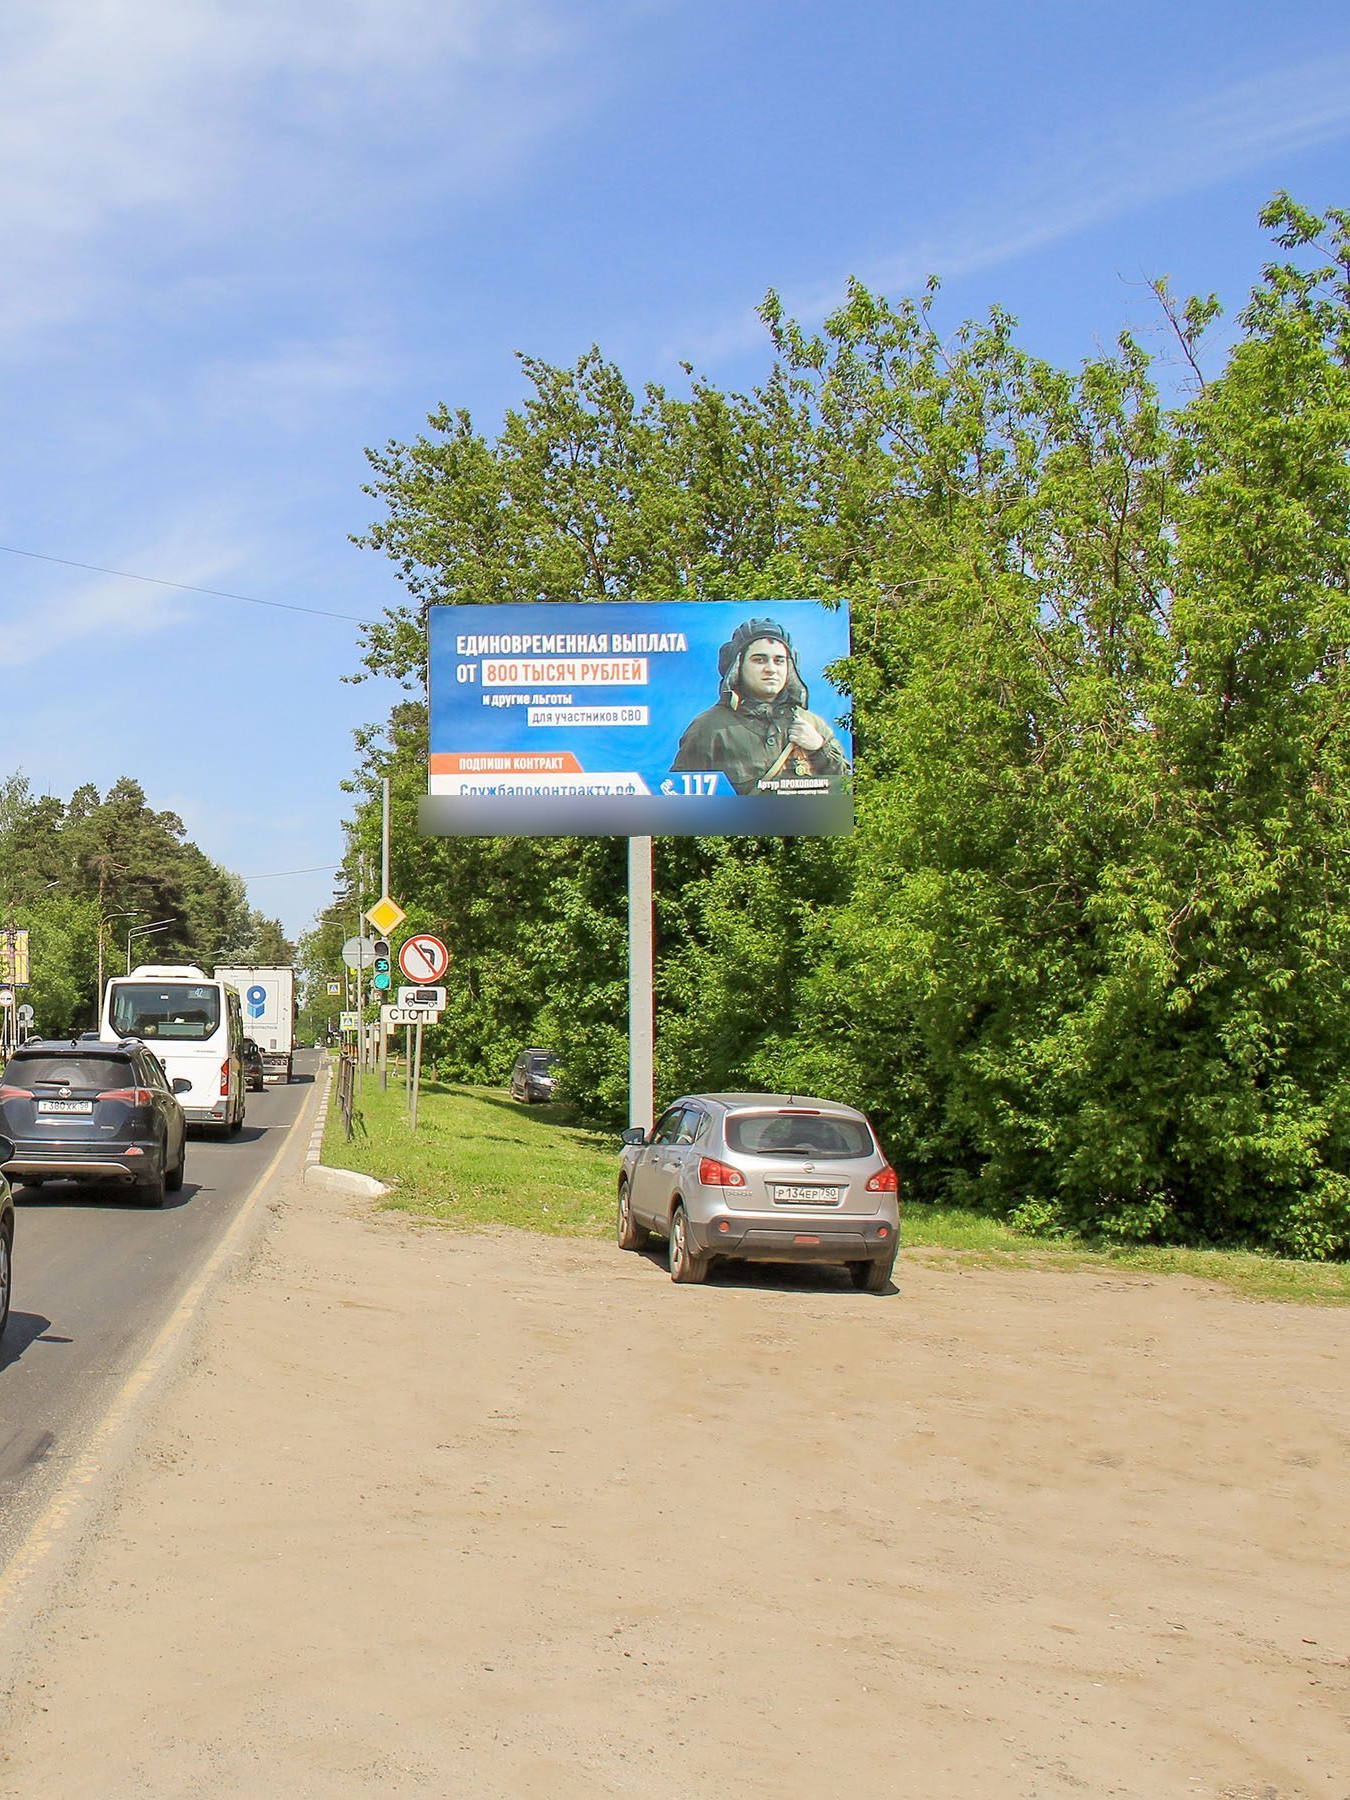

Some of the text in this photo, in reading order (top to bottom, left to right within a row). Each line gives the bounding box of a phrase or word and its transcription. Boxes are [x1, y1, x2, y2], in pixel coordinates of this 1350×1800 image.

[456, 633, 687, 656] ЕДИНОВРЕМЕННАЯ ВЫПЛАТА
[456, 659, 641, 683] ОТ 800 ТЫСЯЧ РУБЛЕЙ
[482, 694, 572, 708] и другие льготы
[532, 709, 641, 725] для участников СВО
[459, 757, 564, 771] ПОДПИШИ КОНТРАКТ
[681, 774, 718, 796] 117
[757, 779, 779, 791] Артур
